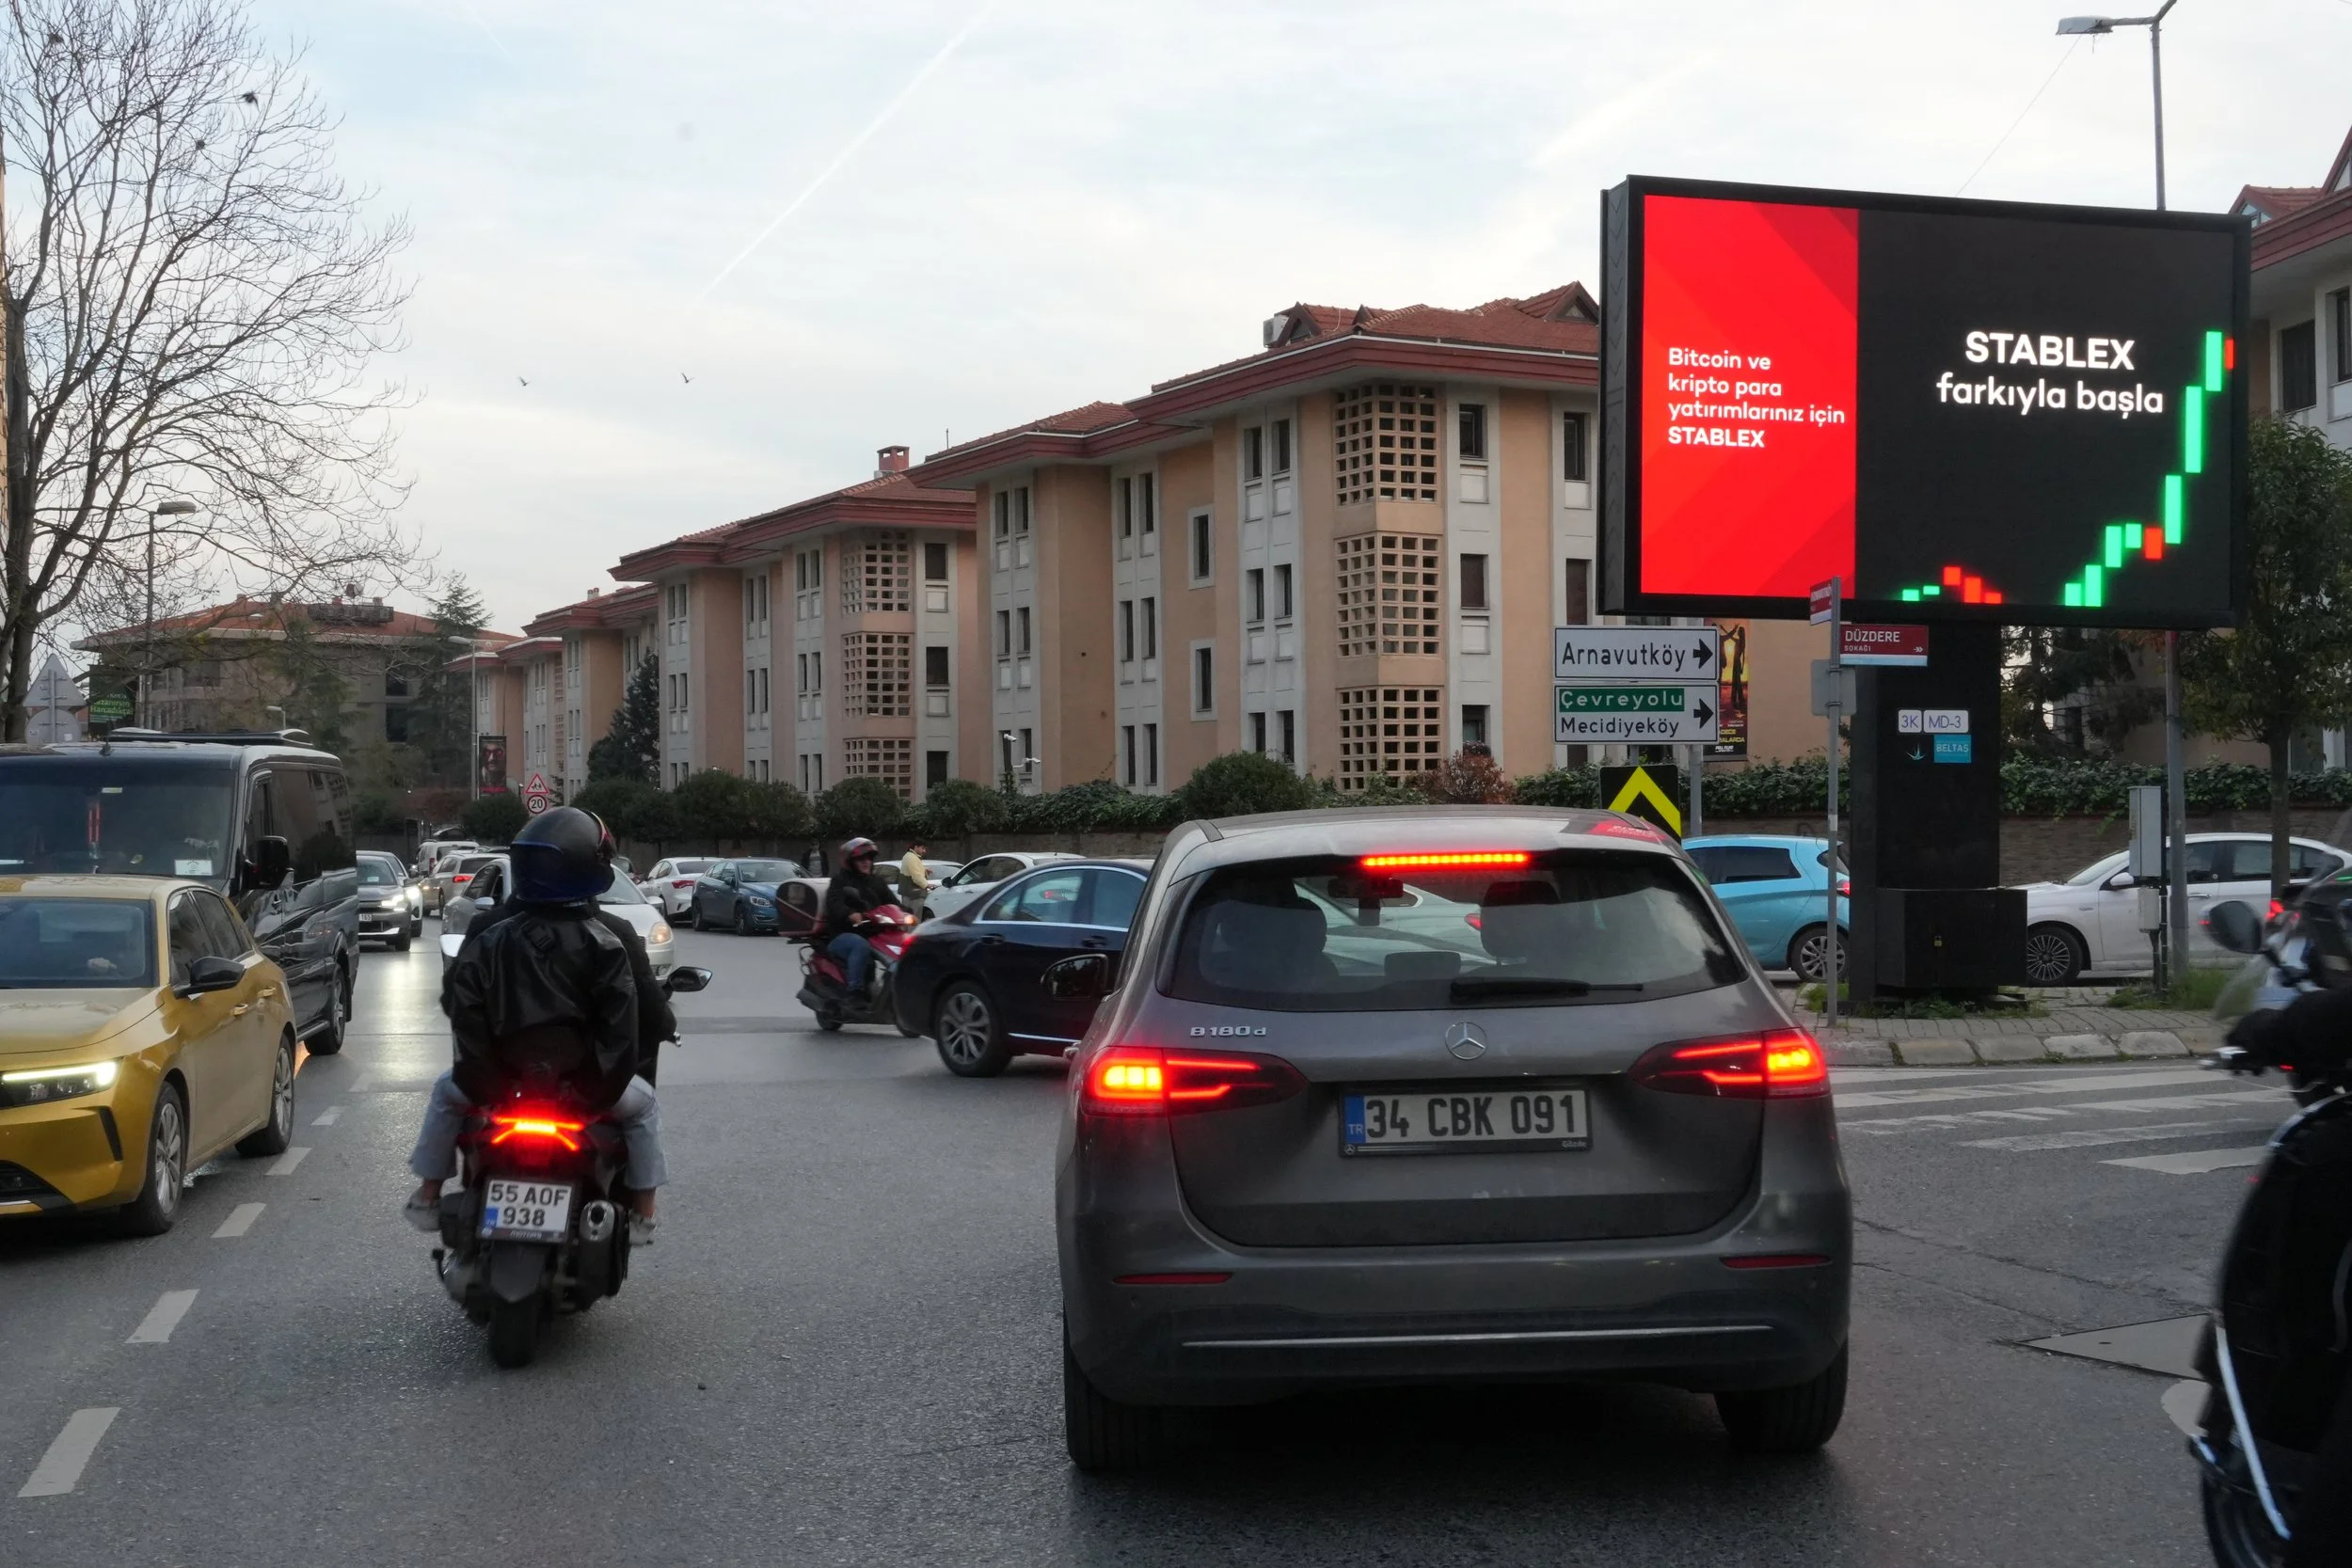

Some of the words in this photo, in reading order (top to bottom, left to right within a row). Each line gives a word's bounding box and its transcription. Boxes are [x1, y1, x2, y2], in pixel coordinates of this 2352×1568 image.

[1669, 347, 1741, 370] Bitcoin
[1747, 356, 1772, 371] ve
[1965, 330, 2136, 371] STABLEX
[1668, 372, 1730, 397] kripto
[1735, 381, 1783, 400] para
[1935, 372, 2066, 416] farkıyla
[2077, 380, 2163, 420] başla
[1668, 400, 1804, 421] yatırımlarınız
[1809, 404, 1845, 427] için
[1668, 426, 1766, 449] STABLEX
[1845, 629, 1900, 643] DÜZDERE
[1562, 641, 1686, 673] Arnavutköy
[1561, 690, 1683, 709] Çevreyolu
[1561, 717, 1679, 737] Mecidiyeköy
[1900, 715, 1919, 729] 3K
[1928, 715, 1962, 729] MD-3
[531, 799, 544, 809] 20
[1366, 1099, 1410, 1138] 34
[1427, 1095, 1494, 1137] CBK
[1510, 1094, 1575, 1134] 091
[1347, 1123, 1363, 1135] TR
[490, 1183, 519, 1203] 55
[523, 1186, 568, 1207] AOF
[502, 1207, 546, 1227] 938
